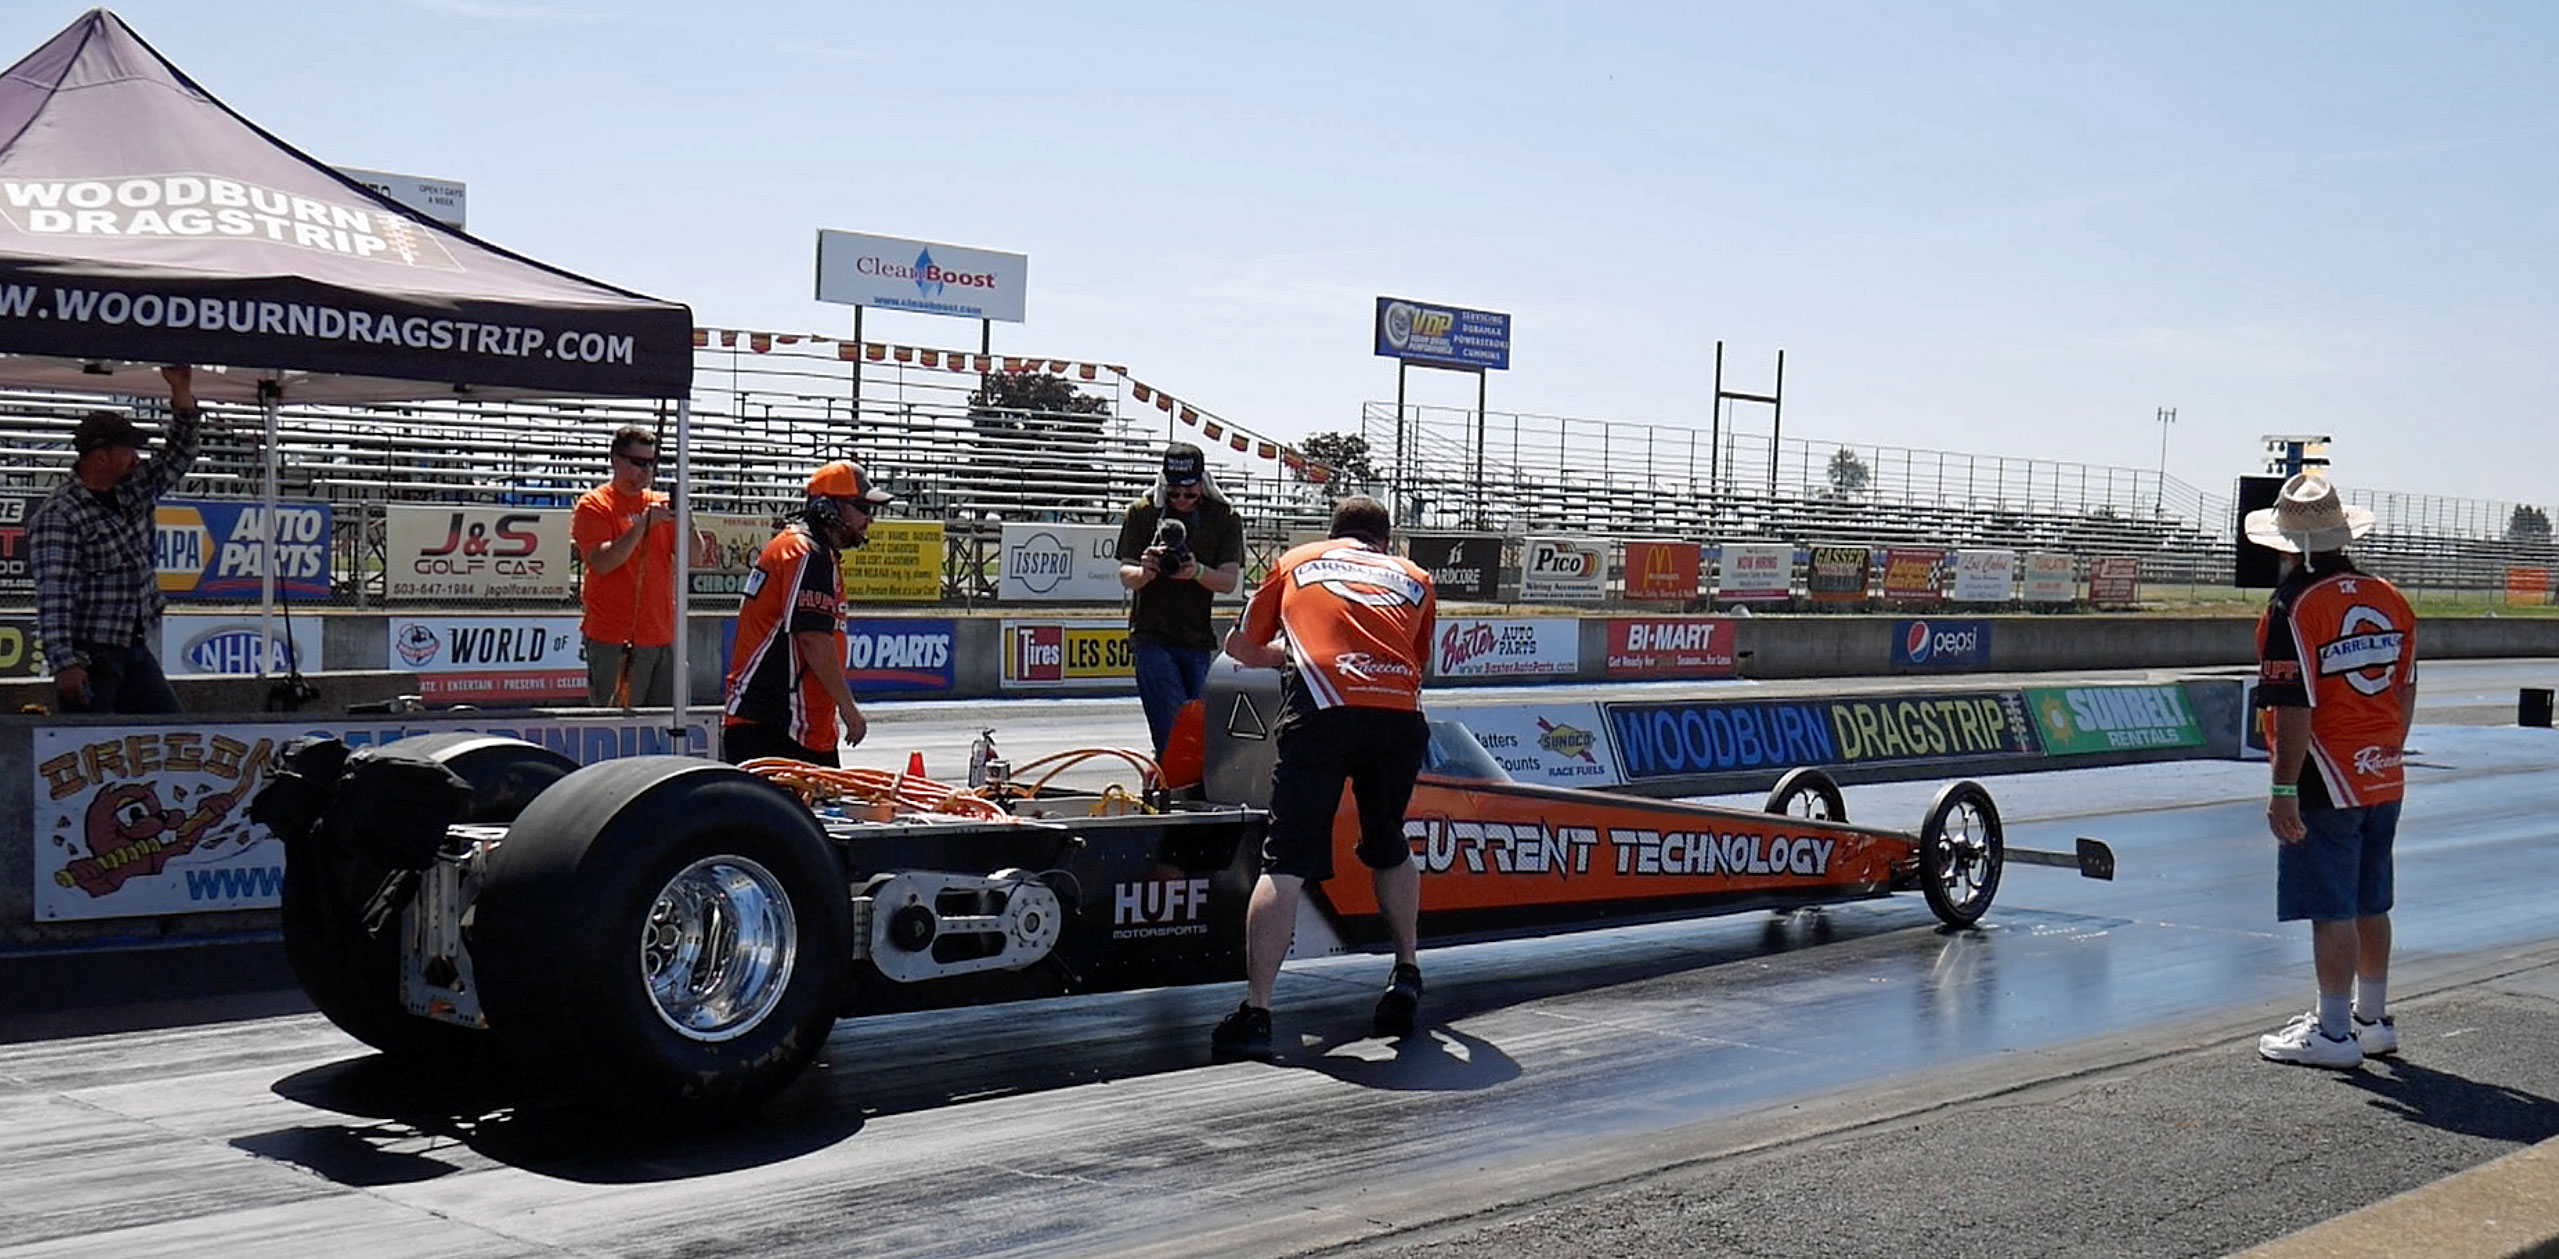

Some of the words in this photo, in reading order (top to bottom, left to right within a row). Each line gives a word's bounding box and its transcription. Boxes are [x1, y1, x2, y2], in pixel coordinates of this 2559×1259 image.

[4, 177, 374, 233] WOODBURN
[29, 209, 387, 256] DRAGSTRIP
[856, 256, 995, 288] CleanBoost
[157, 530, 200, 569] APA
[420, 513, 540, 557] J&S
[217, 542, 322, 577] PARTS
[414, 559, 485, 575] GOLF
[495, 560, 545, 575] CAR
[1016, 552, 1068, 574] ISSPRO
[1815, 548, 1866, 568] GASSER
[200, 635, 287, 673] NHRA
[448, 627, 546, 664] WORLD
[554, 635, 569, 651] OF
[874, 634, 949, 668] PARTS
[1020, 629, 1060, 678] Tires
[1069, 638, 1100, 668] LES
[1441, 621, 1499, 674] Baxter
[1502, 627, 1534, 640] AUTO
[1499, 641, 1537, 655] PARTS
[1933, 626, 1977, 657] pepsi
[1608, 656, 1621, 668] Get
[1621, 656, 1643, 669] Ready
[447, 680, 492, 691] ENTERTAIN
[504, 678, 544, 690] PRESERVE
[557, 677, 588, 688] CELEBR
[2065, 686, 2187, 731] SUNBELT
[1543, 734, 1591, 748] SUNOCO
[1614, 705, 1834, 771] WOODBURN
[1831, 699, 2004, 759] DRAGSTRIP
[2106, 728, 2180, 747] RENTALS
[1549, 766, 1573, 777] RACE
[1577, 765, 1605, 776] FUELS
[1402, 818, 1598, 879] CURRENT
[1609, 828, 1834, 878] TECHNOLOGY
[1114, 878, 1209, 924] HUFF
[1113, 924, 1207, 939] MOTORSPORTS
